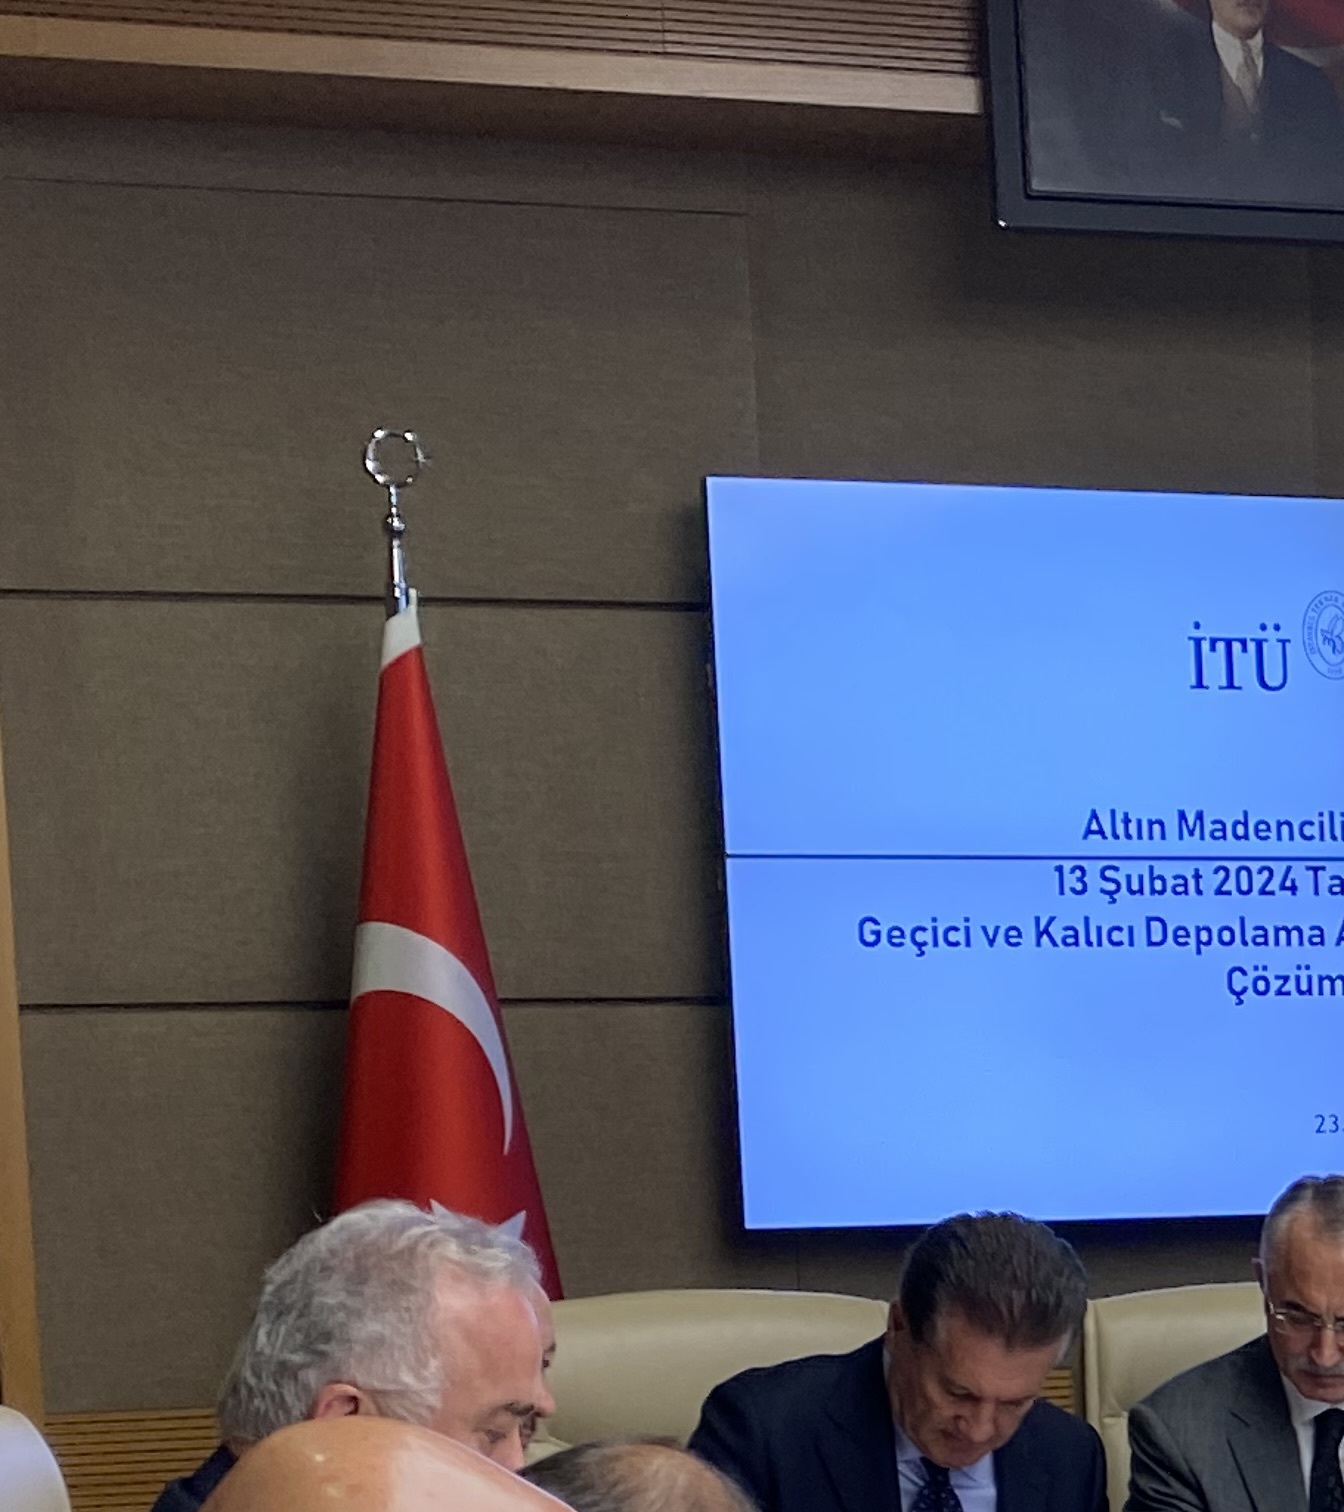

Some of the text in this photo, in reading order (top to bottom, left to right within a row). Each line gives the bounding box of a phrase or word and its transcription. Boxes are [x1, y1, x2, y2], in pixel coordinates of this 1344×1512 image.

[1187, 620, 1291, 691] İTÜ
[1082, 808, 1167, 841] Altın
[1053, 864, 1089, 896] 13
[1099, 864, 1203, 904] Şubat
[1213, 865, 1299, 897] 2024
[857, 915, 973, 957] Geçici
[981, 924, 1023, 949] ve
[1034, 915, 1135, 948] Kalıcı
[1144, 915, 1326, 955] Depolama
